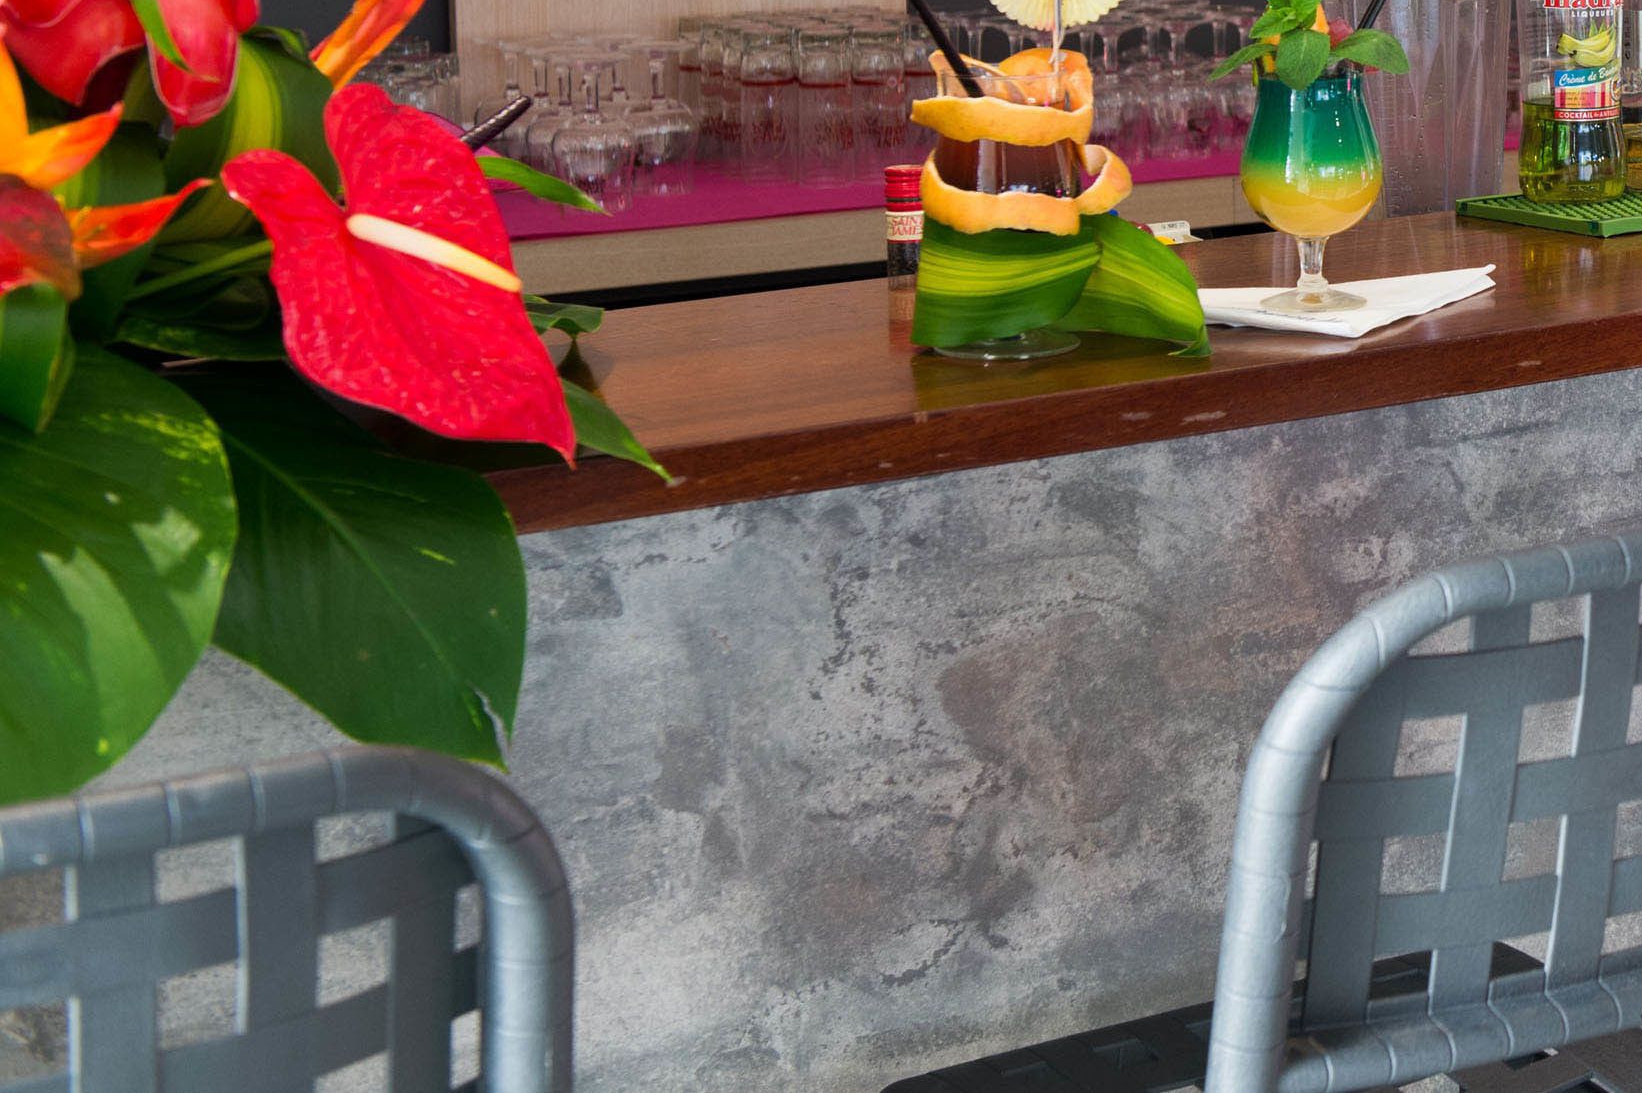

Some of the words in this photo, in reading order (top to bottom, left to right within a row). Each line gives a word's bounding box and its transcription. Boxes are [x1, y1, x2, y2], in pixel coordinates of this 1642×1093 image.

[1571, 9, 1614, 18] LIQUEUR
[1559, 72, 1585, 86] Crème
[1587, 69, 1597, 81] de
[1560, 107, 1593, 119] COCKTAIL
[891, 225, 924, 237] JAME
